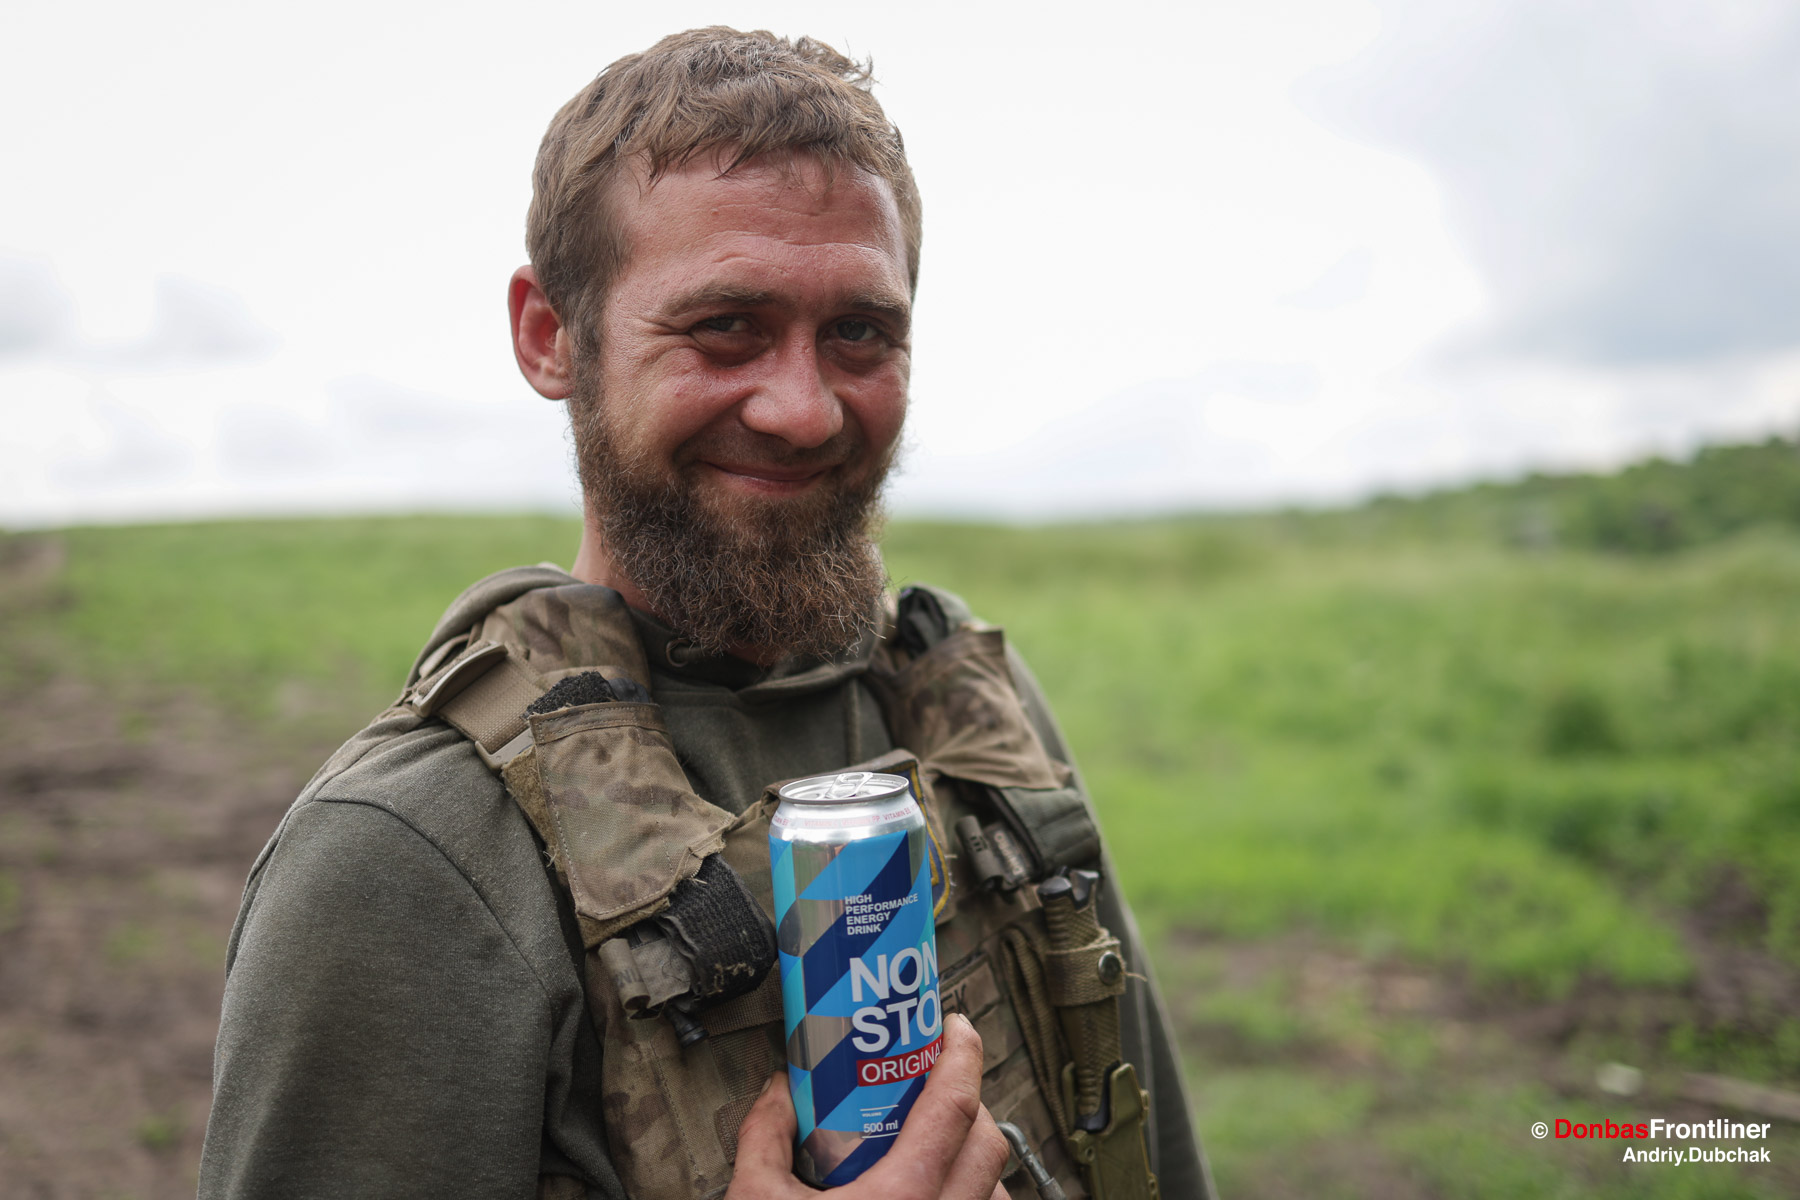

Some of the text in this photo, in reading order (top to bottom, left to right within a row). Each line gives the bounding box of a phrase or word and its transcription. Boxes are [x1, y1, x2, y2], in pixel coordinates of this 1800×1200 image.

[883, 810, 905, 821] VITAMIN
[844, 893, 872, 905] HIGH
[845, 892, 919, 915] PERFORMANCE
[846, 911, 891, 925] ENERGY
[847, 923, 882, 936] DRINK
[849, 934, 939, 1003] NON
[851, 982, 942, 1053] STO
[861, 1039, 942, 1083] ORIGINA
[863, 1119, 899, 1133] 500 ml
